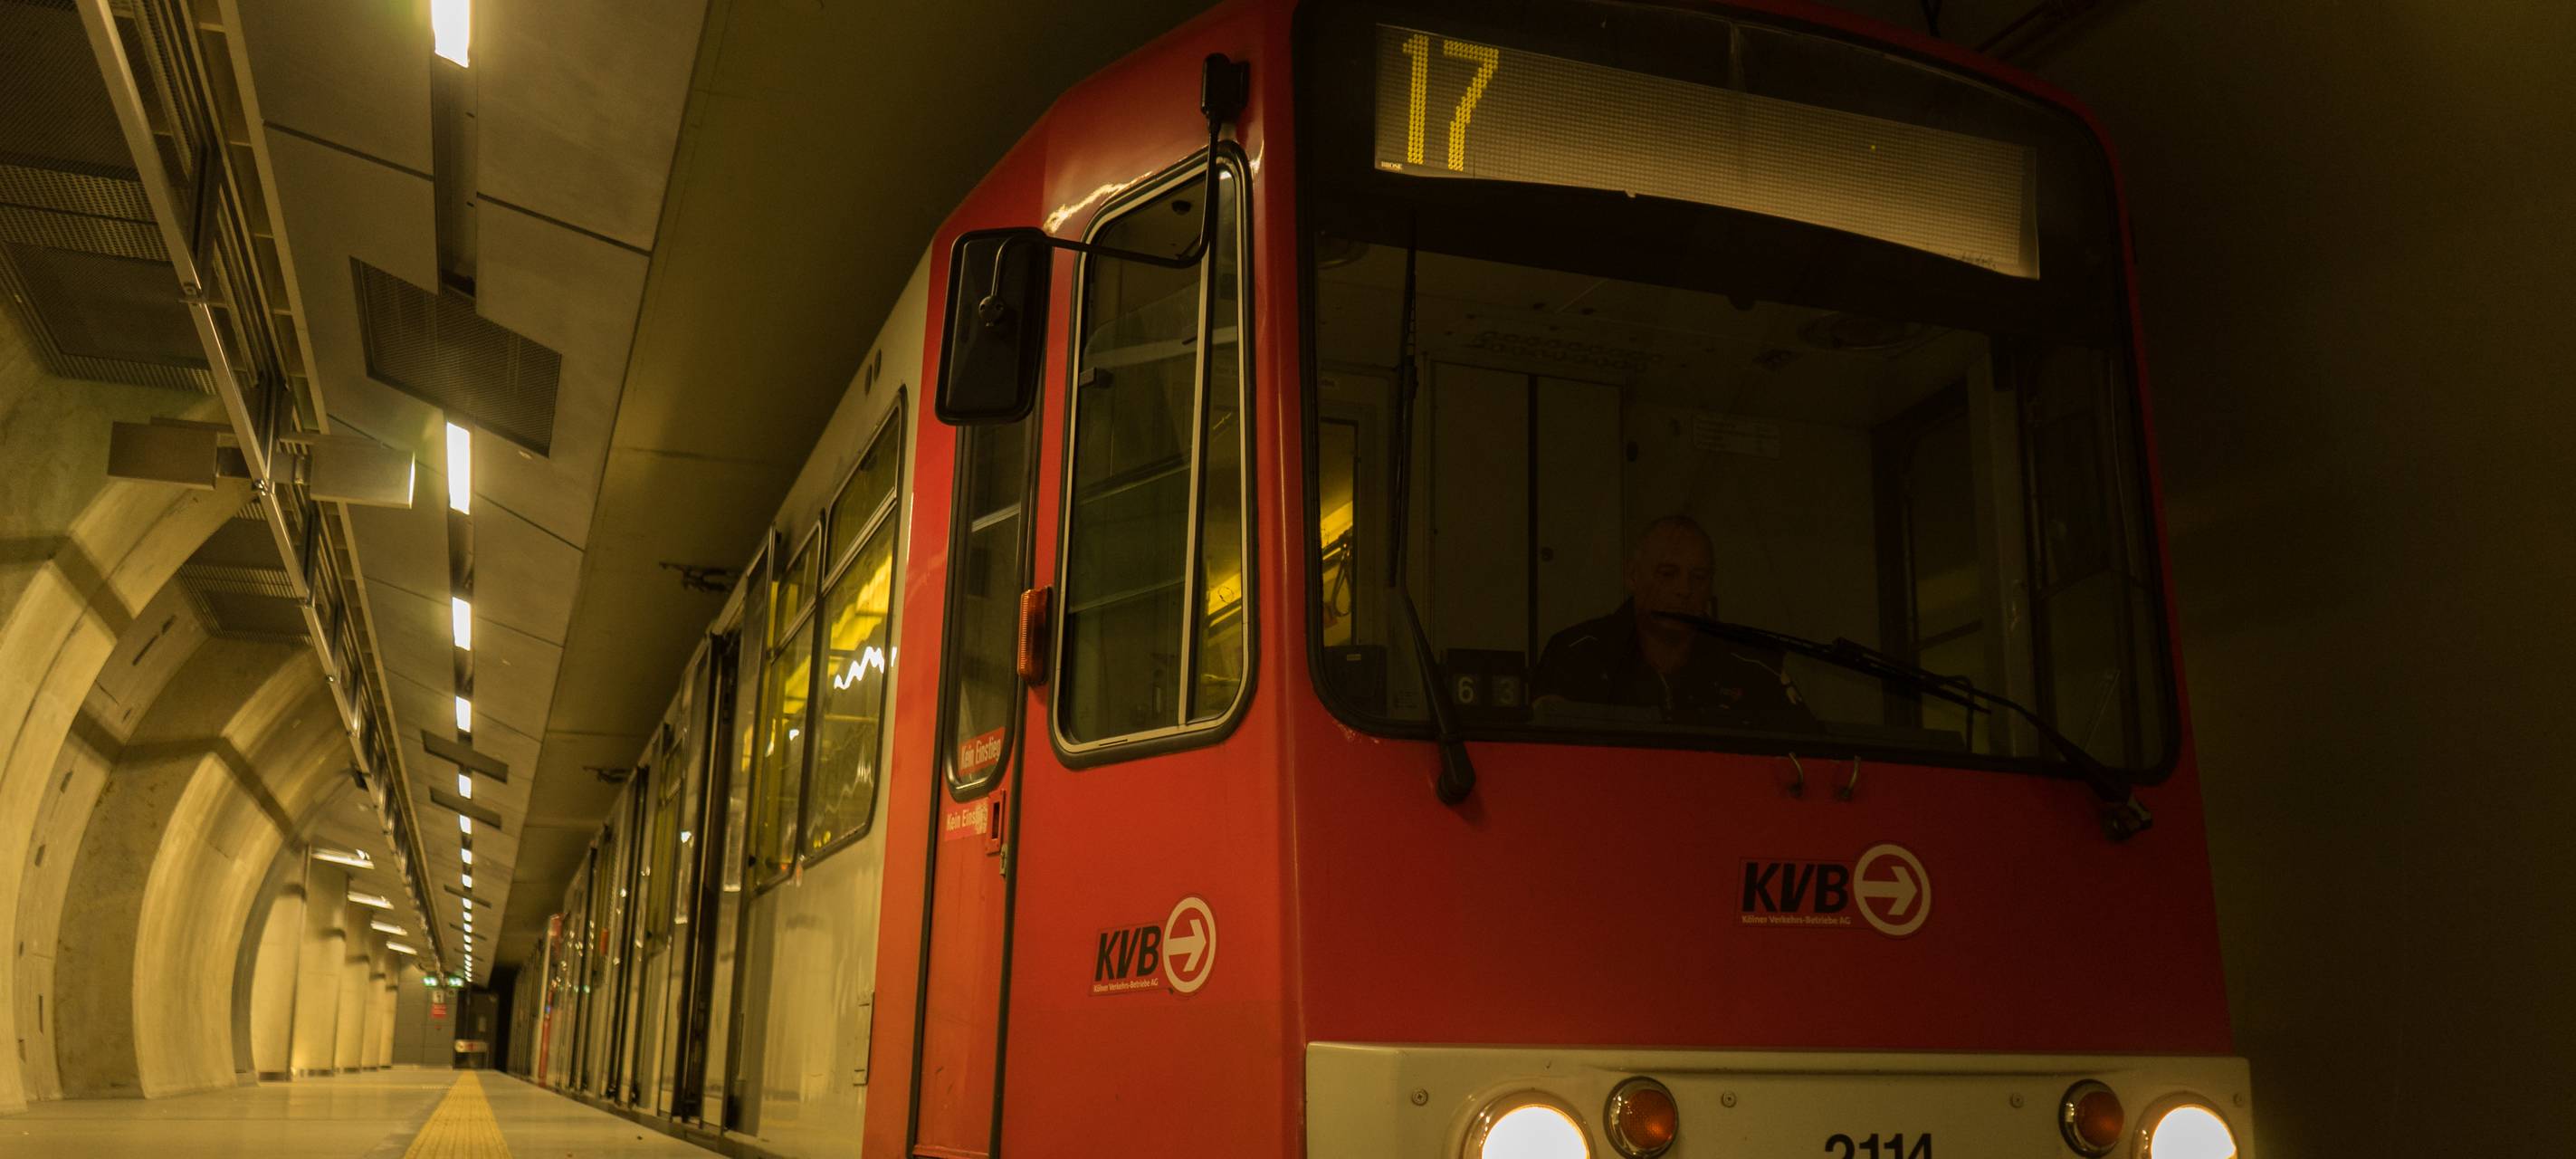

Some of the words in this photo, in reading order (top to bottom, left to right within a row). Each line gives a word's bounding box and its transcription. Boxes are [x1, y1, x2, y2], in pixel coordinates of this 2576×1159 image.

[1402, 34, 1500, 171] 17
[959, 744, 975, 769] Kein
[976, 735, 1001, 764] Einstieg
[946, 811, 961, 831] Kein
[1742, 862, 1849, 913] KVB
[1741, 915, 1768, 924] Kölner
[1839, 916, 1852, 924] AG
[1095, 925, 1161, 982] KVB
[1093, 983, 1109, 992] Kölner
[1150, 978, 1159, 986] AG
[1825, 1133, 1932, 1159] 2114
